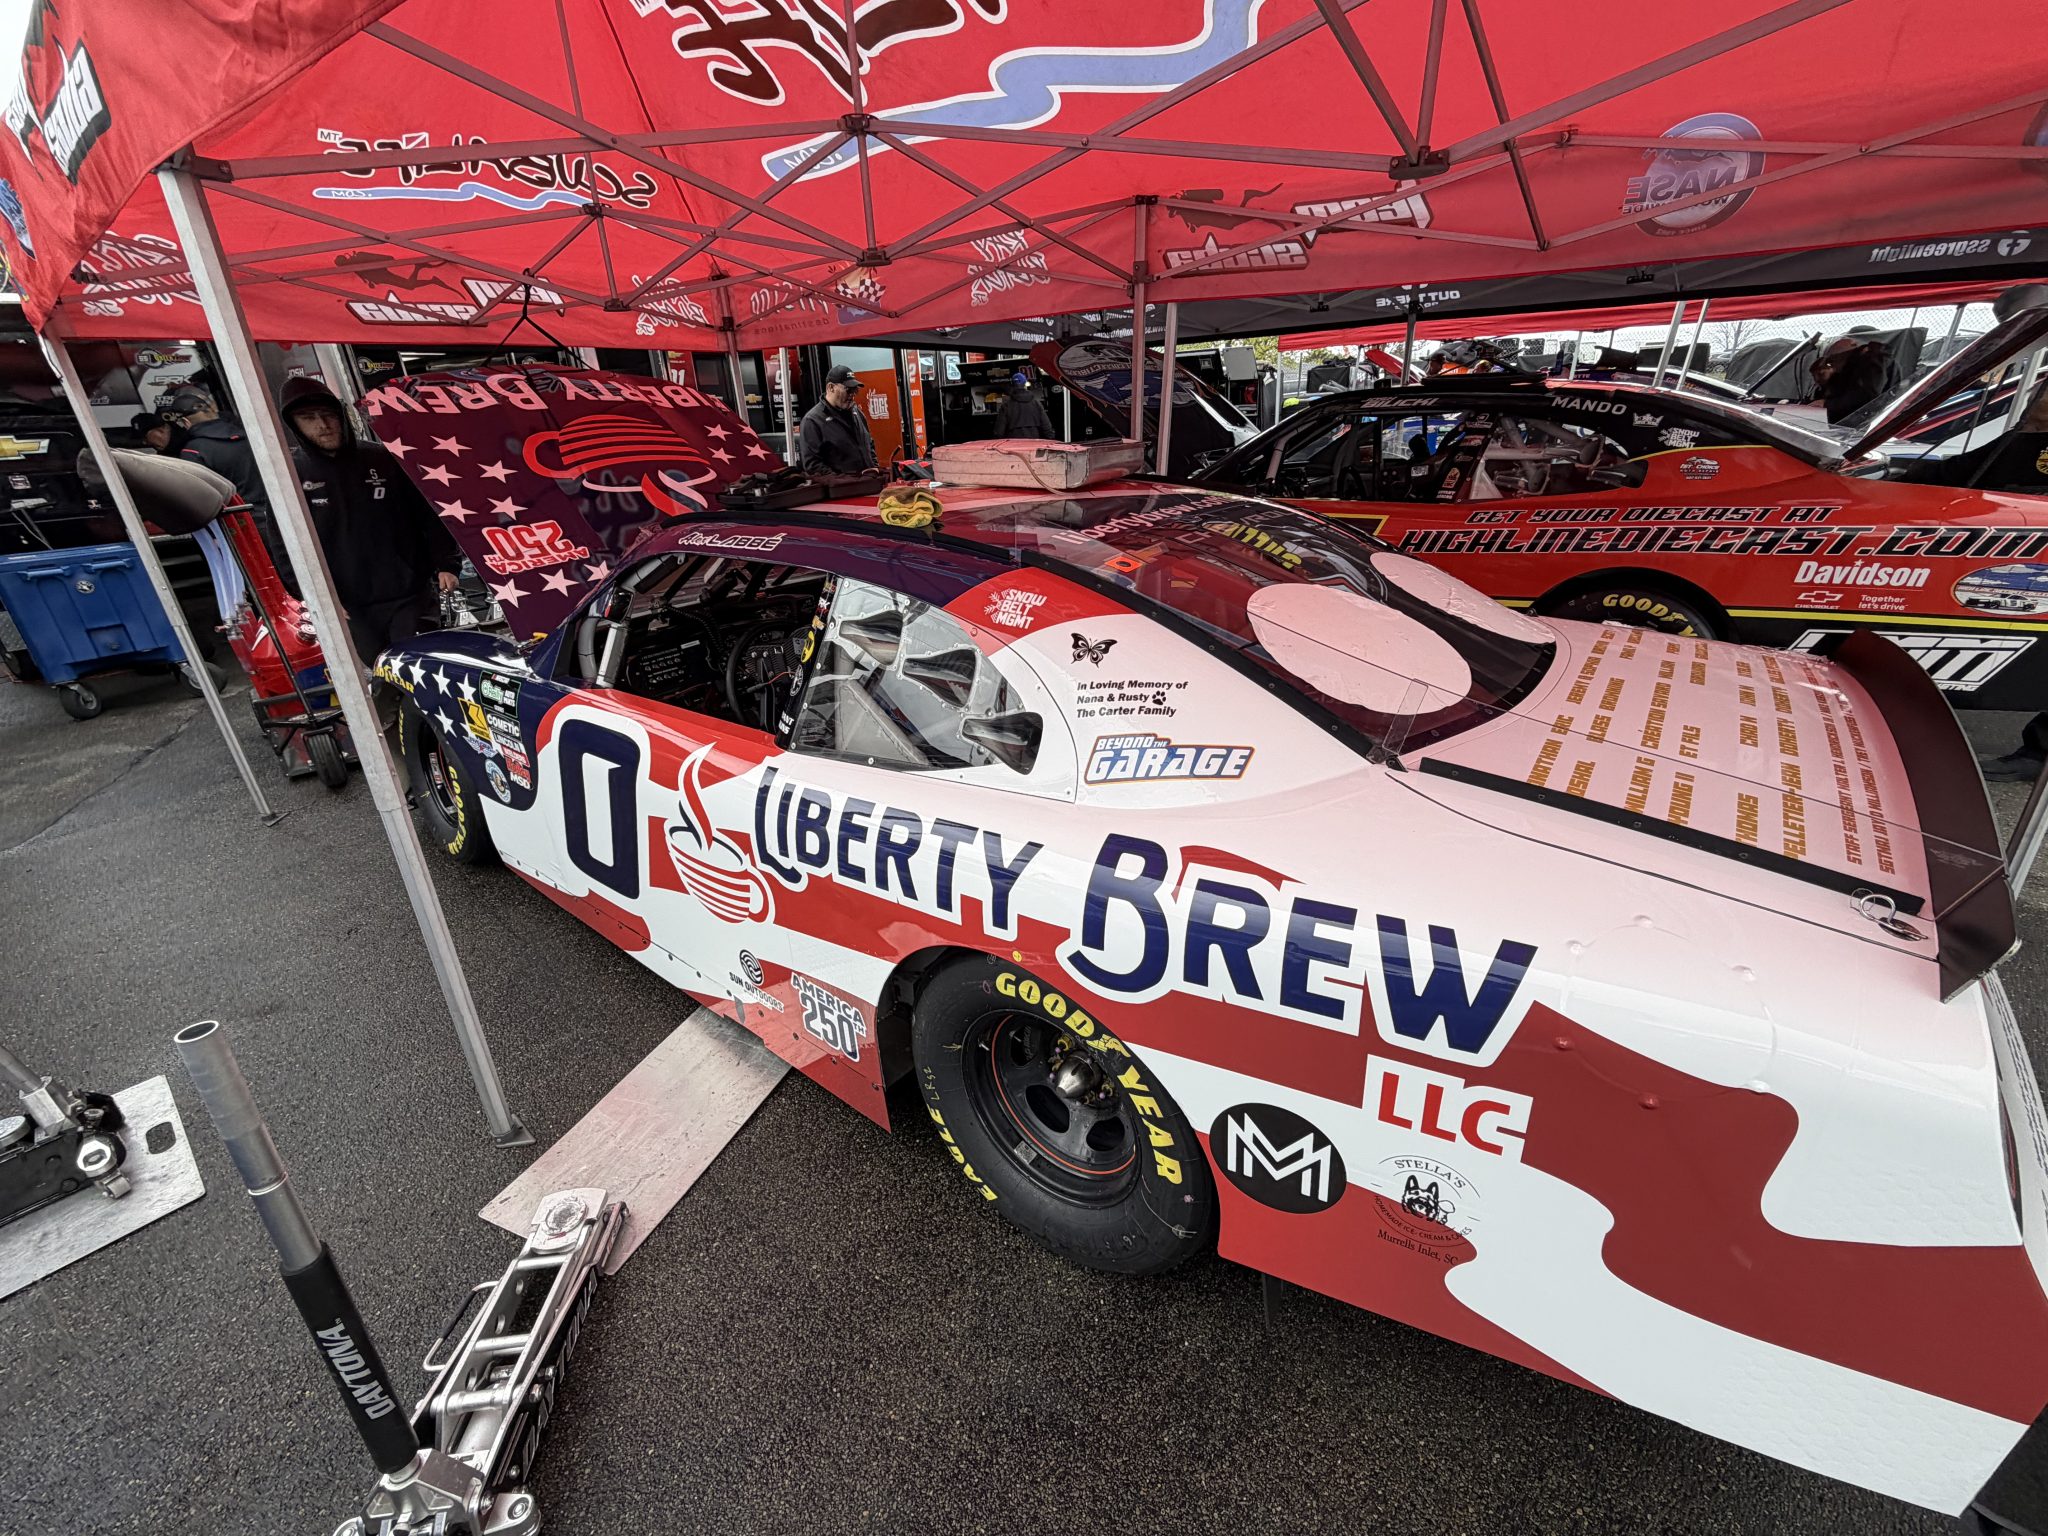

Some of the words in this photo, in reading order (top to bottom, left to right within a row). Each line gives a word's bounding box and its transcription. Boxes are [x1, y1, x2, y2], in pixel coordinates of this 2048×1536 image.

[366, 373, 549, 417] BREW
[1551, 396, 1628, 415] MANDO
[1668, 440, 1696, 448] MGMT
[1670, 434, 1692, 442] BELT
[1673, 427, 1700, 437] SNOW
[1466, 509, 1527, 524] GET
[1527, 509, 1616, 523] YOUR
[1619, 506, 1785, 522] DIECAST
[1781, 506, 1842, 522] AT
[1399, 526, 2048, 559] HIGHLINEDIECAST.COM
[1794, 559, 1931, 587] Davidson
[1002, 599, 1034, 617] BELT
[1008, 589, 1047, 607] SNOW
[1859, 602, 1879, 610] let's
[1861, 594, 1905, 603] Together
[996, 612, 1035, 629] MGMT
[1076, 694, 1104, 704] Nana
[1107, 694, 1115, 702] &
[1118, 693, 1150, 703] Rusty
[1077, 681, 1087, 690] In
[1090, 680, 1124, 691] Loving
[1127, 680, 1173, 690] Memory
[1176, 681, 1189, 690] of
[1566, 680, 1590, 705] JEREMY
[1599, 677, 1625, 711] BROWNING
[1076, 708, 1095, 718] The
[1099, 706, 1135, 717] Carter
[1138, 705, 1177, 717] Family
[1771, 686, 1792, 714] DOHERTY
[487, 714, 520, 737] COMETIC
[1551, 714, 1574, 735] ERIC
[1681, 724, 1701, 746] FILS
[1740, 720, 1758, 748] CHAD
[1777, 717, 1799, 757] DOHERTY
[1098, 736, 1154, 750] BEYOND
[1679, 744, 1699, 759] ET
[1087, 747, 1251, 782] GARAGE
[1527, 738, 1563, 787] ONATHAN
[510, 772, 531, 790] MSD
[1566, 760, 1596, 798] OSHAL
[1624, 765, 1653, 814] WILLIAM
[1667, 781, 1694, 825] YOUNG
[1838, 790, 1858, 834] SERGEANT
[1735, 793, 1759, 848] THOMAS
[1844, 833, 1862, 865] STAFF
[754, 765, 1045, 932] LIBERTY
[1067, 833, 1539, 1055] BREW
[729, 971, 744, 988] SUN
[745, 982, 784, 1012] OUTDOORS
[791, 973, 865, 1027] AMERICA
[800, 993, 859, 1060] 250
[853, 1022, 864, 1034] TH
[995, 972, 1095, 1037] GOOD
[1117, 1065, 1183, 1185] YEAR
[1377, 1072, 1511, 1156] LLC
[927, 1103, 998, 1201] EAGLE
[1394, 1159, 1466, 1188] STELLA'S
[1374, 1195, 1402, 1227] HOMEMADE
[1419, 1231, 1444, 1240] CREAM
[1377, 1229, 1415, 1251] Murrells
[1418, 1243, 1441, 1261] Inlet,
[1444, 1253, 1459, 1265] SC
[317, 1322, 395, 1421] DAYTONA
